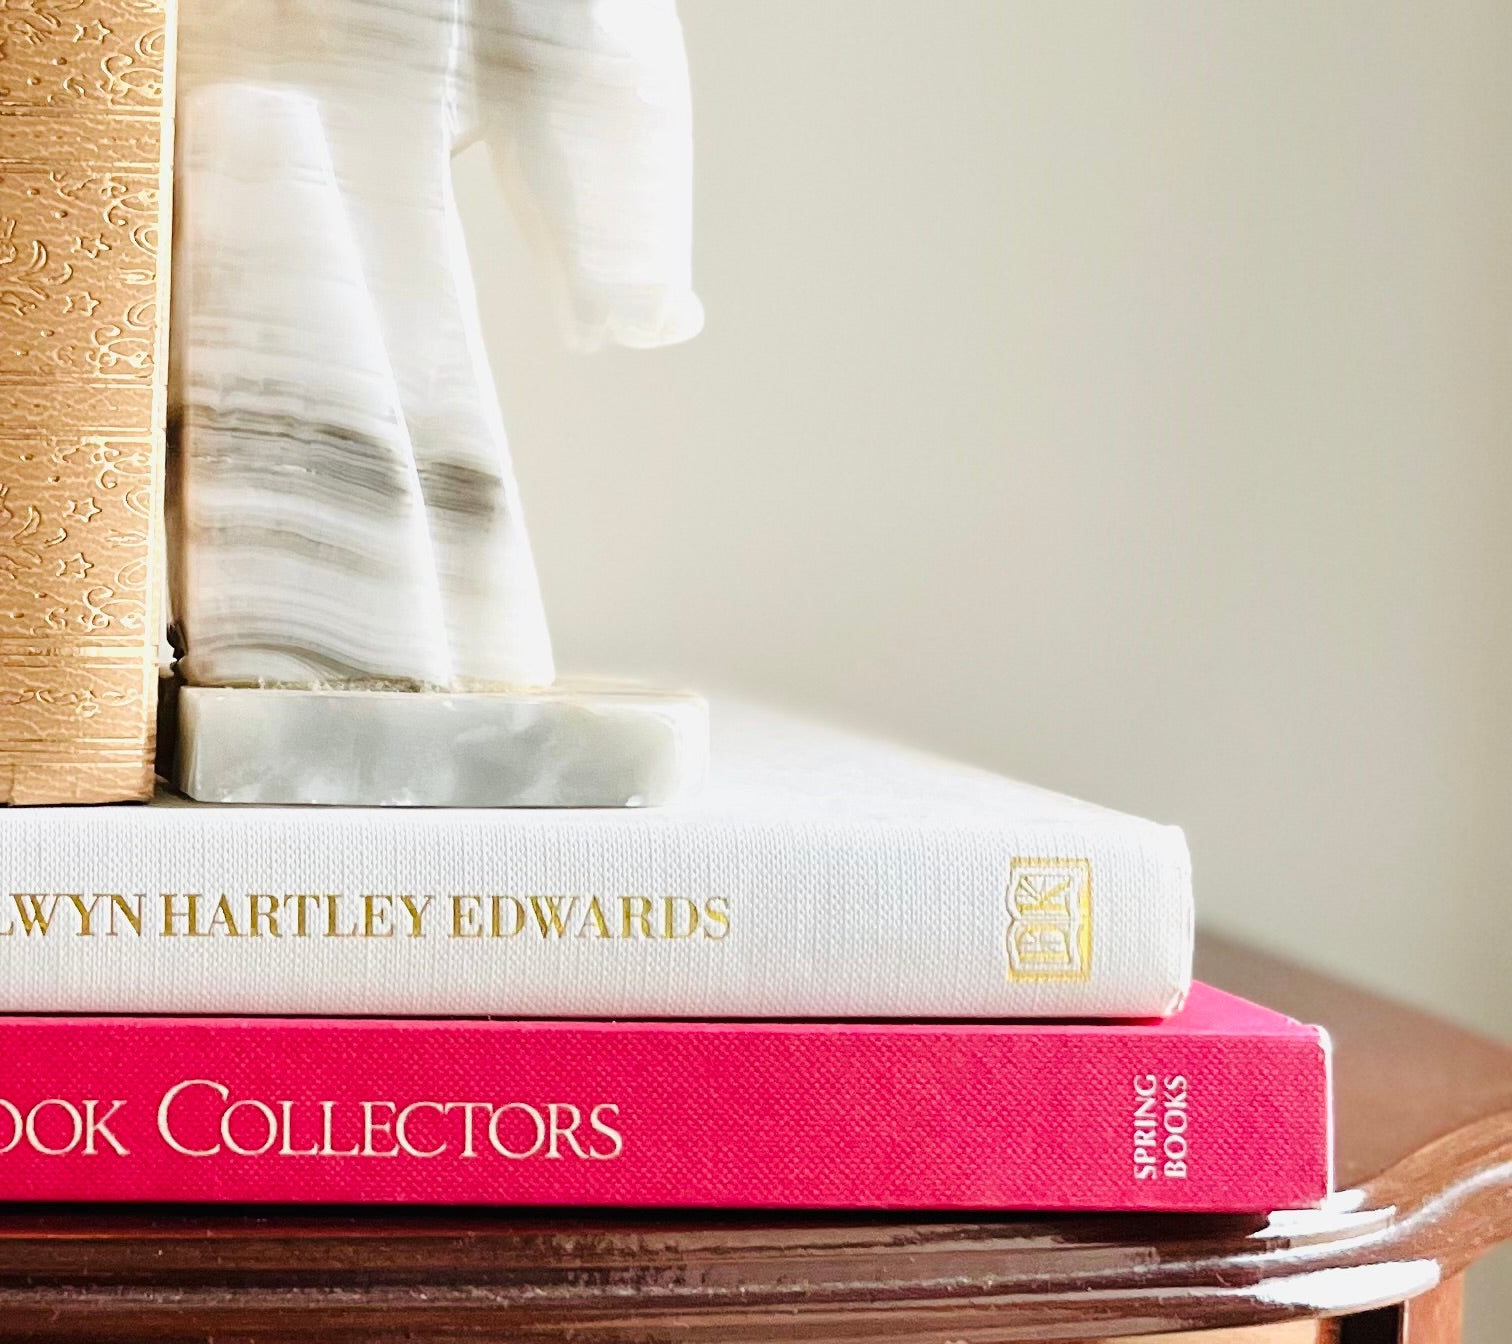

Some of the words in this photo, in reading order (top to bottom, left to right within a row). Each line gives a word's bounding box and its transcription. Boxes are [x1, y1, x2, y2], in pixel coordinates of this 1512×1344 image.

[159, 892, 437, 940] HARTLEY
[449, 894, 731, 941] EDWARDS
[156, 1079, 624, 1161] COLLECTORS
[1133, 1073, 1157, 1180] SPRING
[1163, 1074, 1187, 1180] BOOKS
